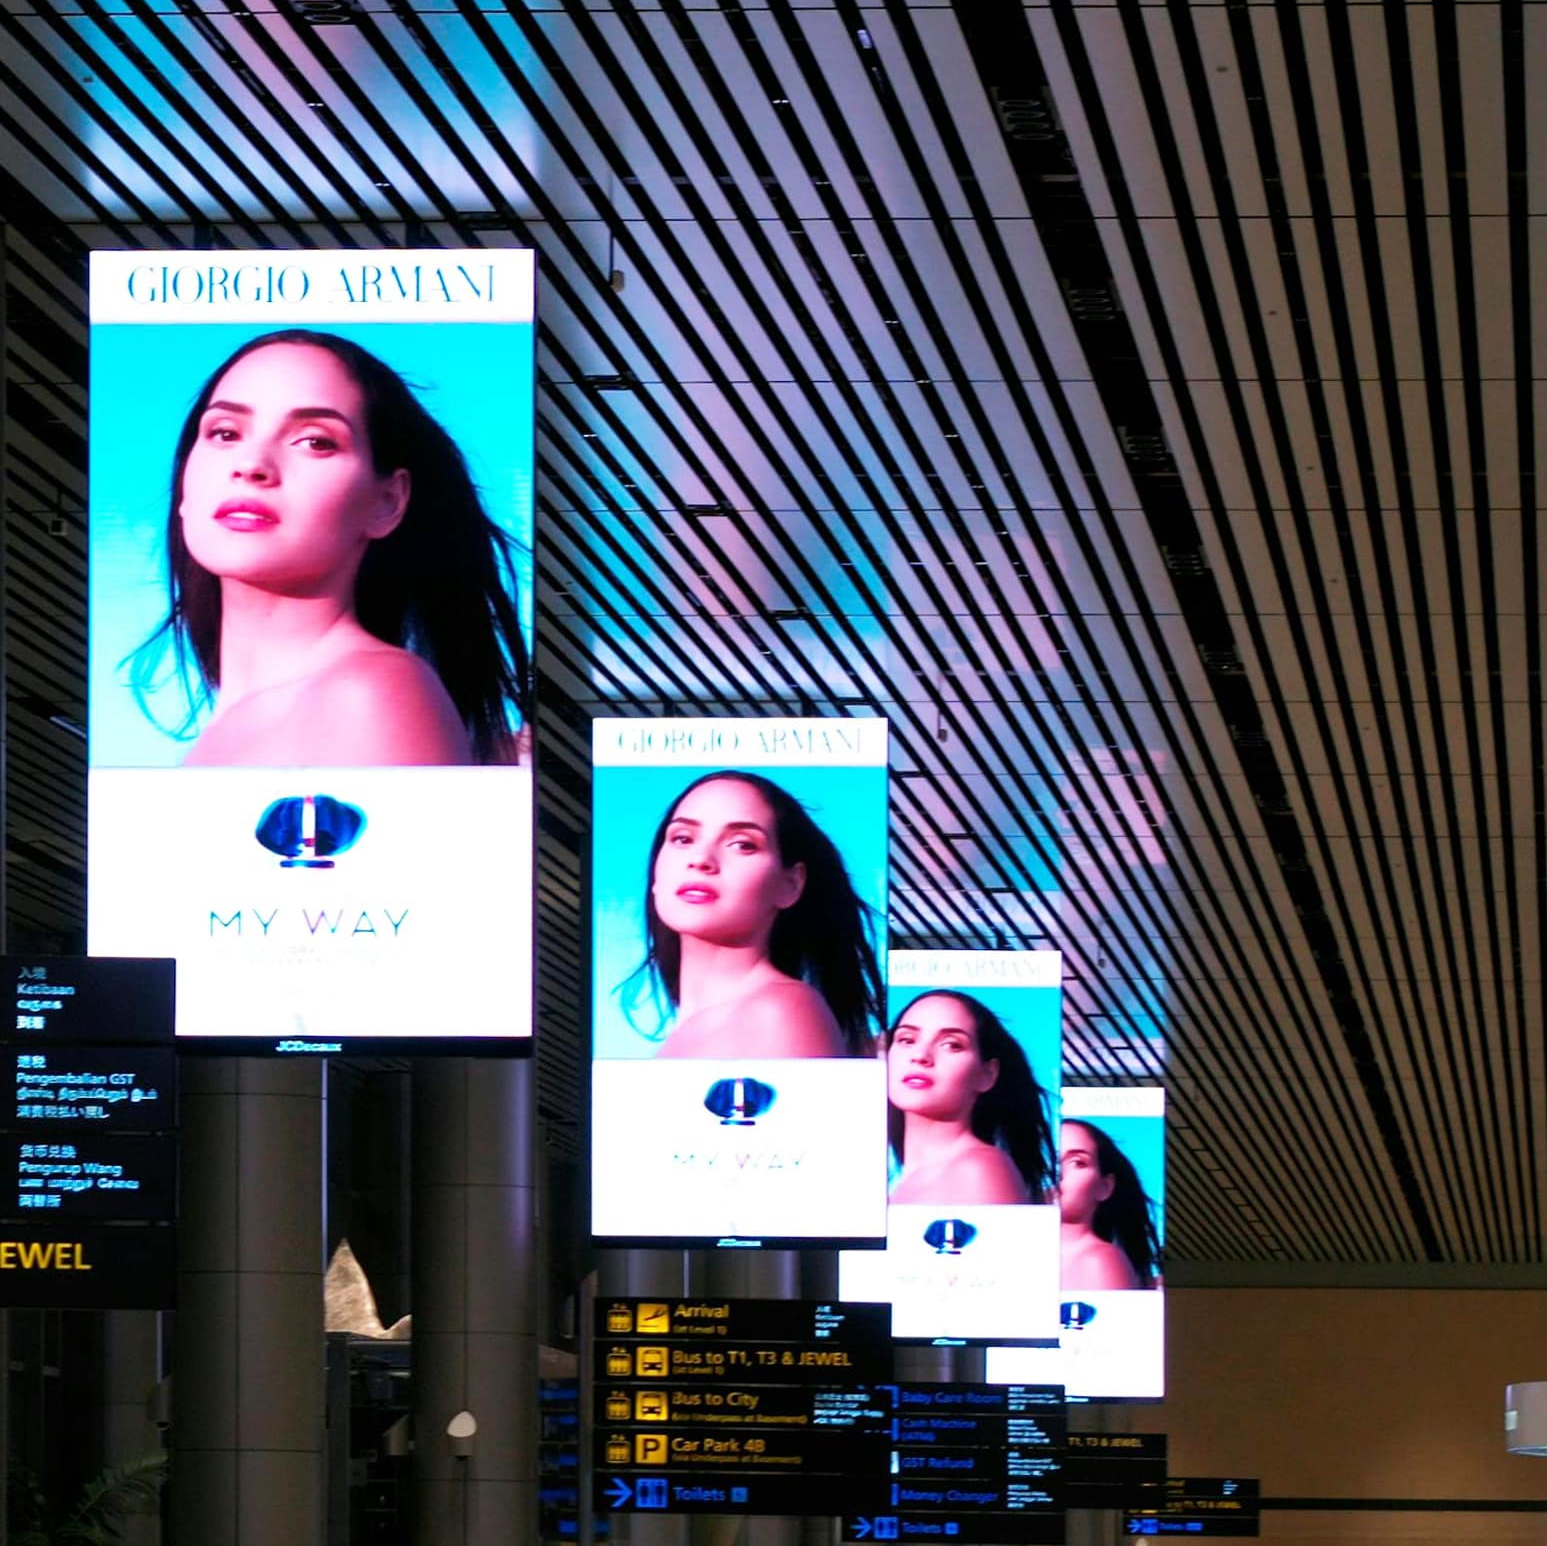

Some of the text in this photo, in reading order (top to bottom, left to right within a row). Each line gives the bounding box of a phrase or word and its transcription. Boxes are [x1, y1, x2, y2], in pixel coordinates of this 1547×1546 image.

[127, 265, 495, 304] GIORGIO ARMANI
[618, 728, 862, 753] GIORGIO ARMANI
[209, 908, 409, 937] MY WAY
[16, 1072, 136, 1086] Pengembalian GST
[673, 1304, 729, 1318] Arrival
[672, 1350, 853, 1367] Bus to T1, T3 & JEWEL
[672, 1392, 759, 1409] Bus to City
[643, 1438, 660, 1459] P
[671, 1437, 700, 1451] Car
[704, 1438, 739, 1451] Park
[673, 1486, 726, 1501] Toilets
[902, 1490, 943, 1502] Money
